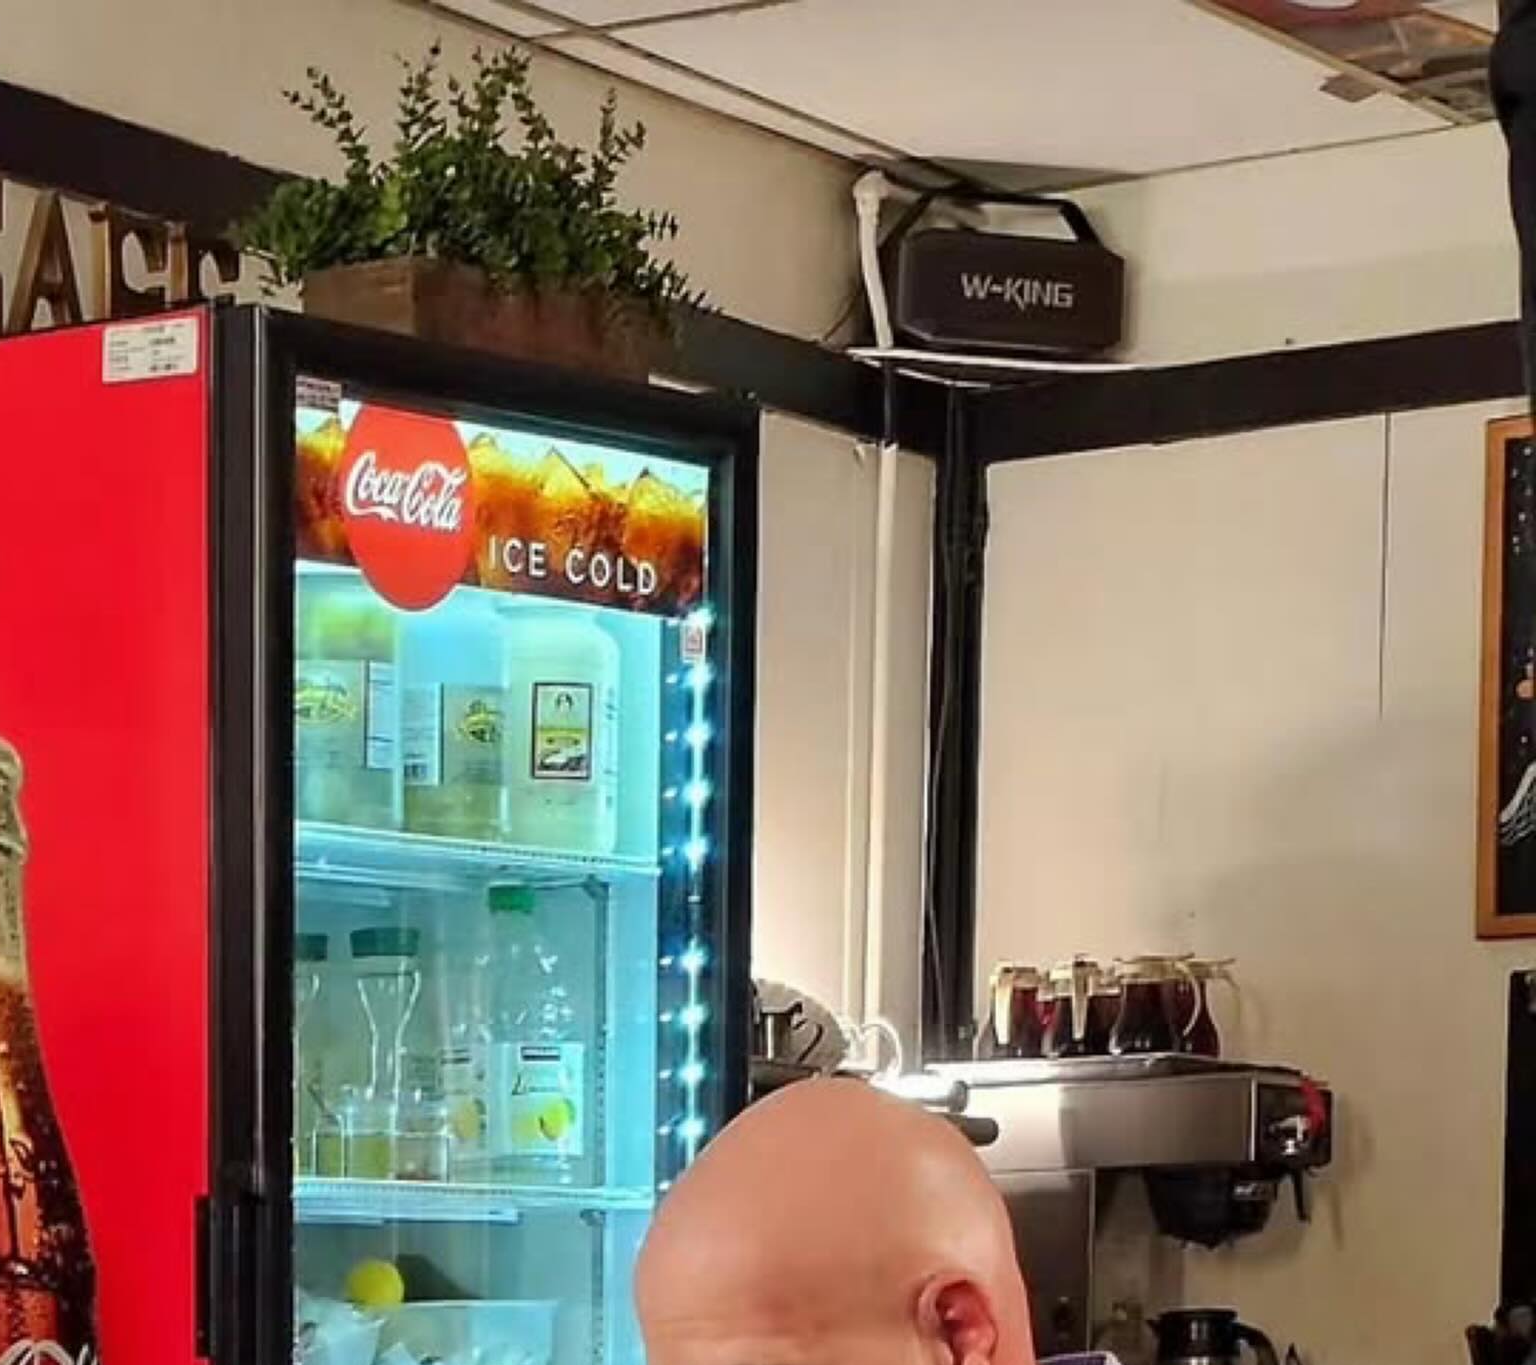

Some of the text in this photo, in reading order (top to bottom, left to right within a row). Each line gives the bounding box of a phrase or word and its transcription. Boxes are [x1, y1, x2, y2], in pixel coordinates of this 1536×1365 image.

[961, 272, 1073, 310] W-KING
[345, 451, 468, 531] Coca-Cola
[488, 534, 657, 595] ICE COLD
